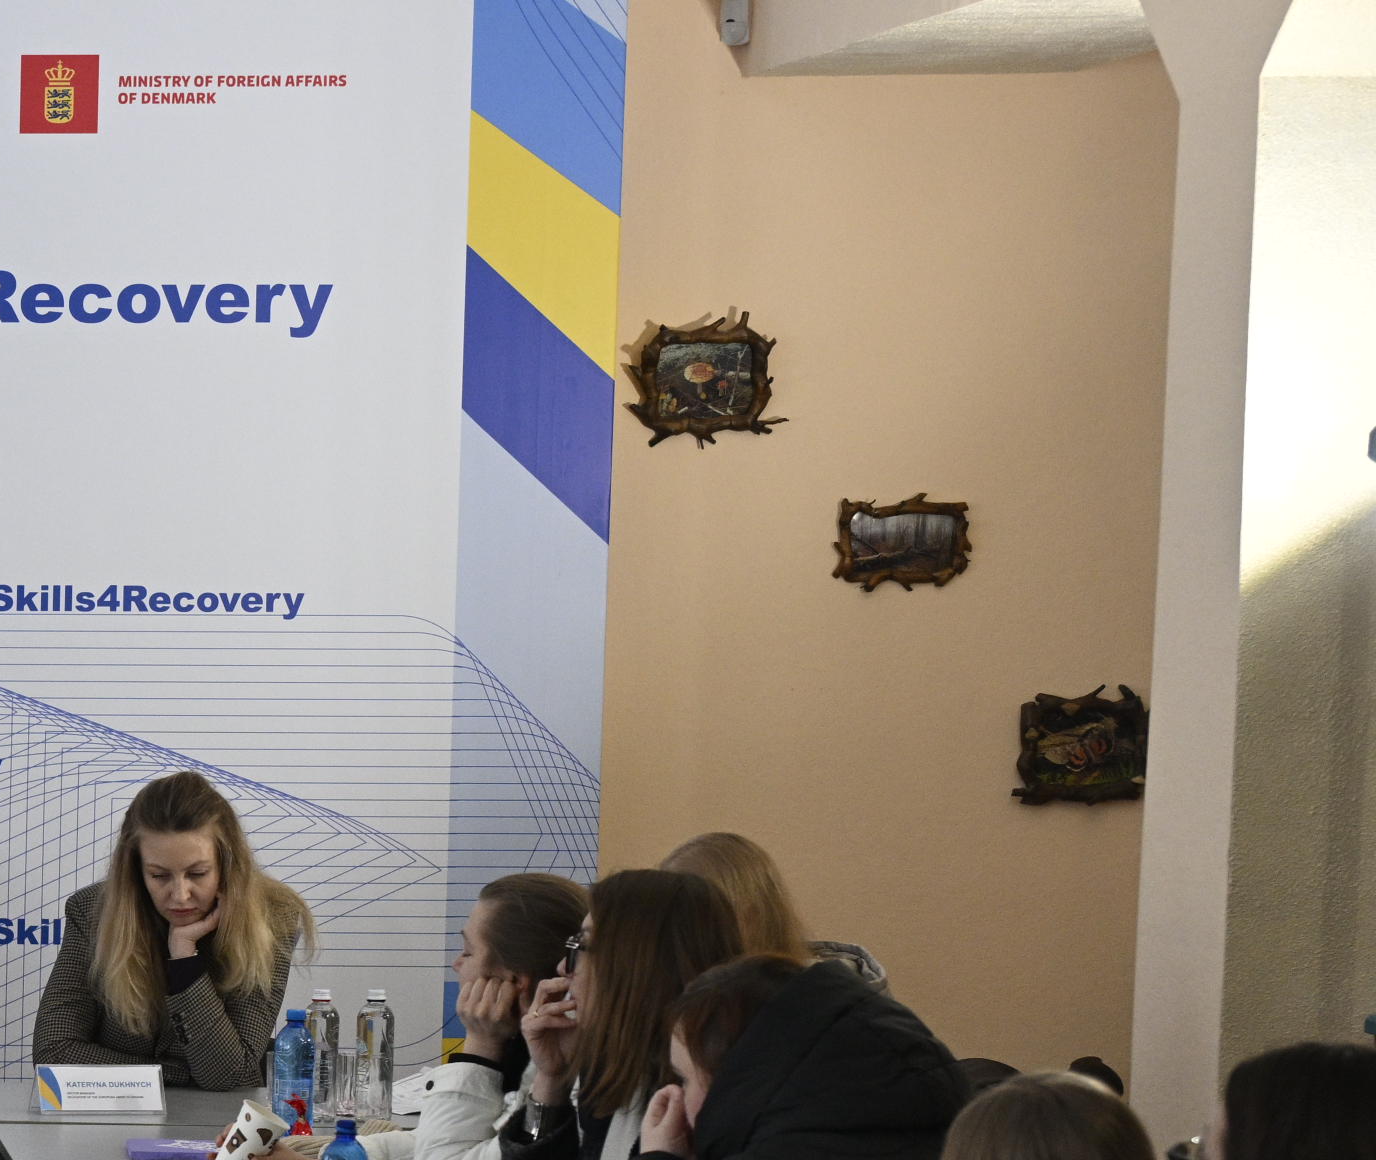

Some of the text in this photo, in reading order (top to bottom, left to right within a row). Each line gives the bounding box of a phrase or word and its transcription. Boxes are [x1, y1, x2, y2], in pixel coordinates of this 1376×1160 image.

[118, 74, 347, 88] MINISTRY OF FOREIGN AFFAIRS
[117, 92, 217, 105] OF DENMARK
